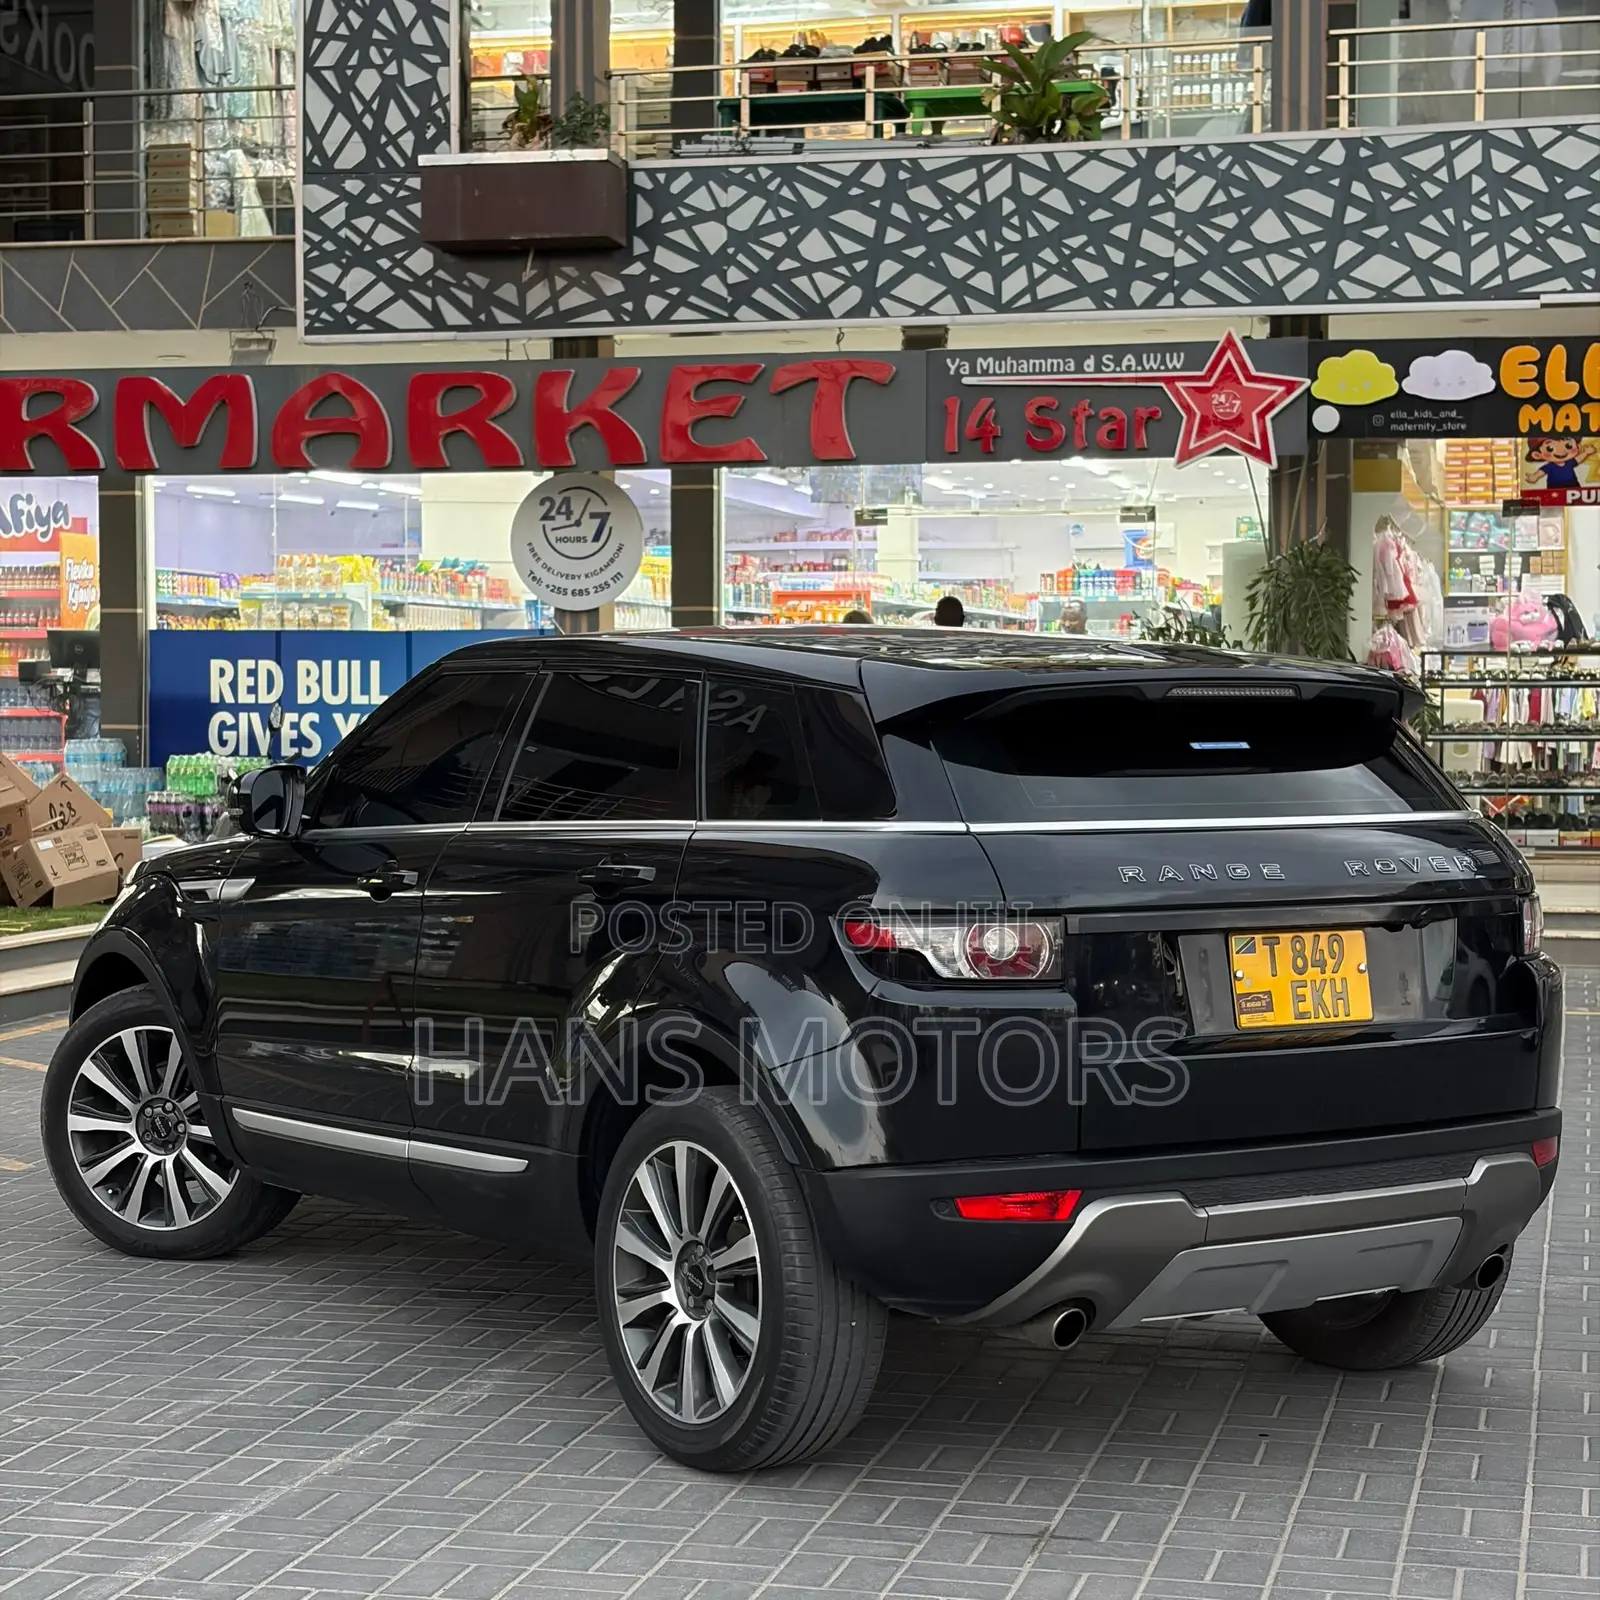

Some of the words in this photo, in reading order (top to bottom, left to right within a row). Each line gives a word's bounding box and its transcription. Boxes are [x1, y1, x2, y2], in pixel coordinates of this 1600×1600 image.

[946, 357, 970, 375] Ya
[976, 356, 1075, 374] Muhamma
[1101, 352, 1185, 372] S.A.W.W
[0, 359, 897, 471] RMARKET
[943, 396, 1001, 454] 14
[1025, 396, 1162, 452] Star
[1566, 490, 1600, 504] PU
[555, 536, 588, 544] HOURS
[526, 542, 543, 562] FREE
[541, 562, 582, 580] DELIVERY
[584, 543, 625, 580] KIGAMBONI
[527, 569, 543, 587] Tel:
[545, 584, 569, 597] +255
[571, 588, 591, 597] 685
[593, 580, 611, 594] 255
[209, 658, 284, 704] RED
[297, 659, 389, 705] BULL
[208, 711, 322, 758] GIVES
[332, 712, 373, 740] Y
[1117, 863, 1286, 883] RANGE
[1343, 855, 1478, 877] ROVER
[1261, 936, 1281, 977] T
[1290, 933, 1345, 976] 849
[1290, 977, 1351, 1020] EKH
